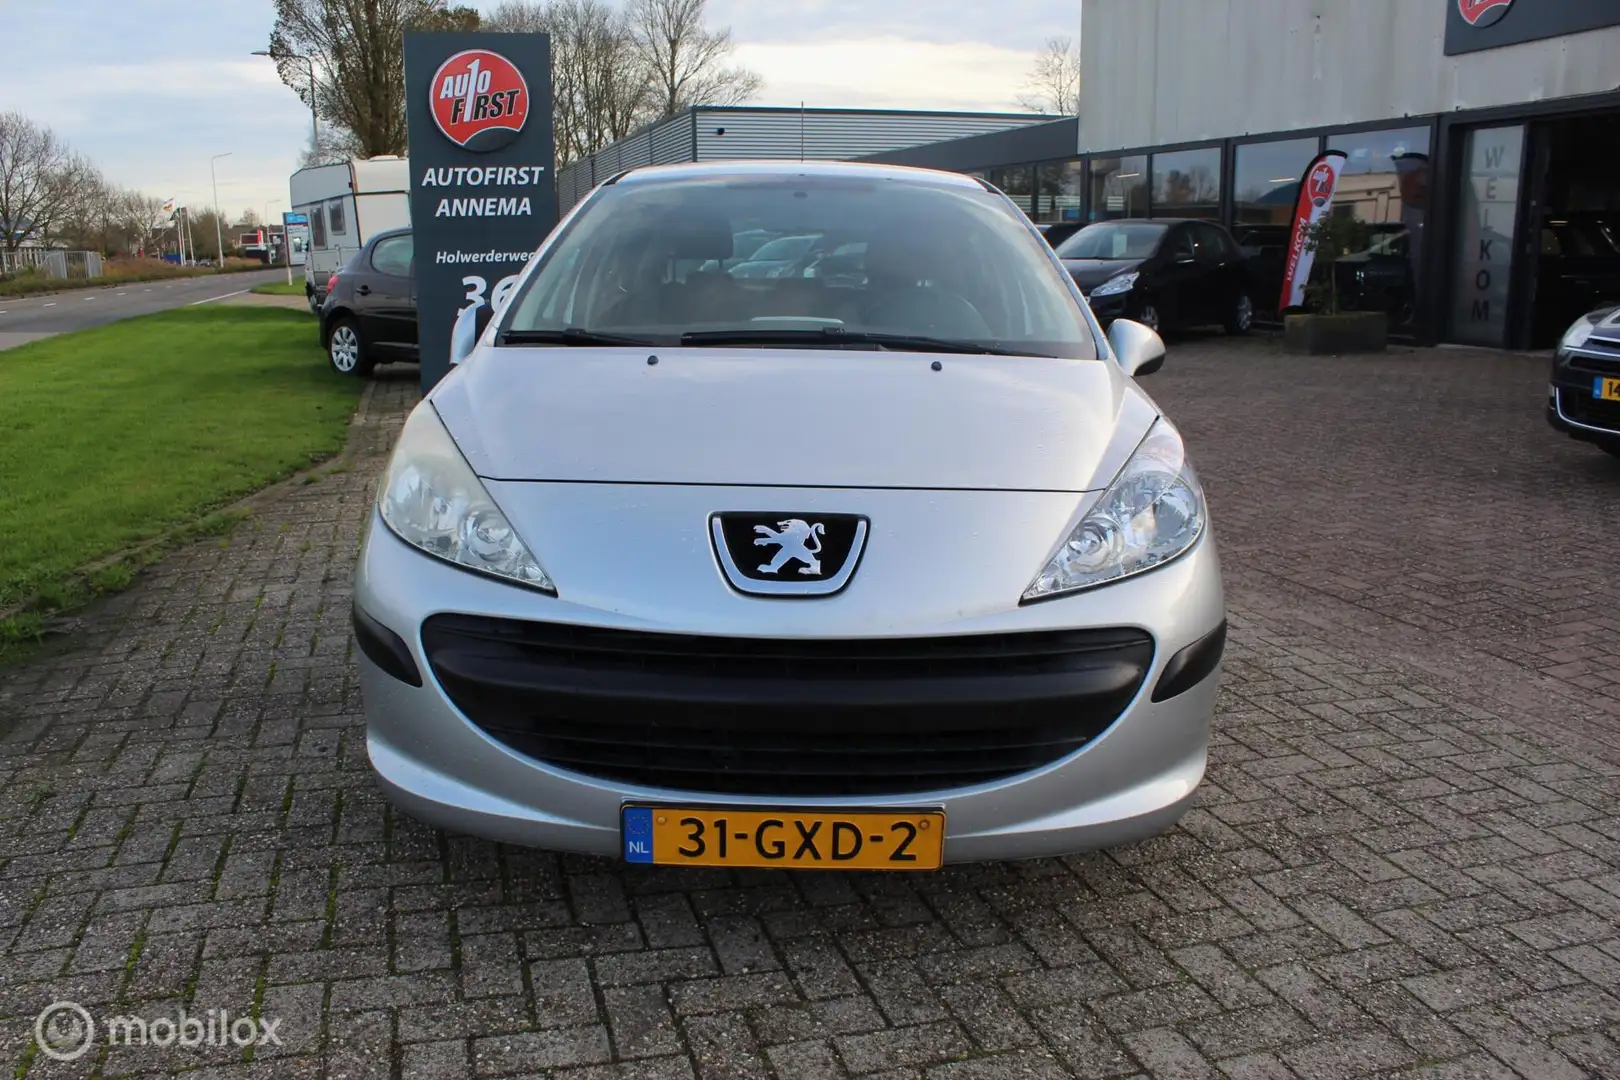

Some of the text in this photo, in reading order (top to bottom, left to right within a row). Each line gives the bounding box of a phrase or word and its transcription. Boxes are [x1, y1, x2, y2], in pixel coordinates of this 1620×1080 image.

[421, 166, 544, 187] AUTOFIRST
[435, 197, 532, 217] ANNEMA
[1471, 146, 1505, 321] WELKOM
[629, 841, 649, 854] NL
[678, 817, 918, 862] 31-GXD-2
